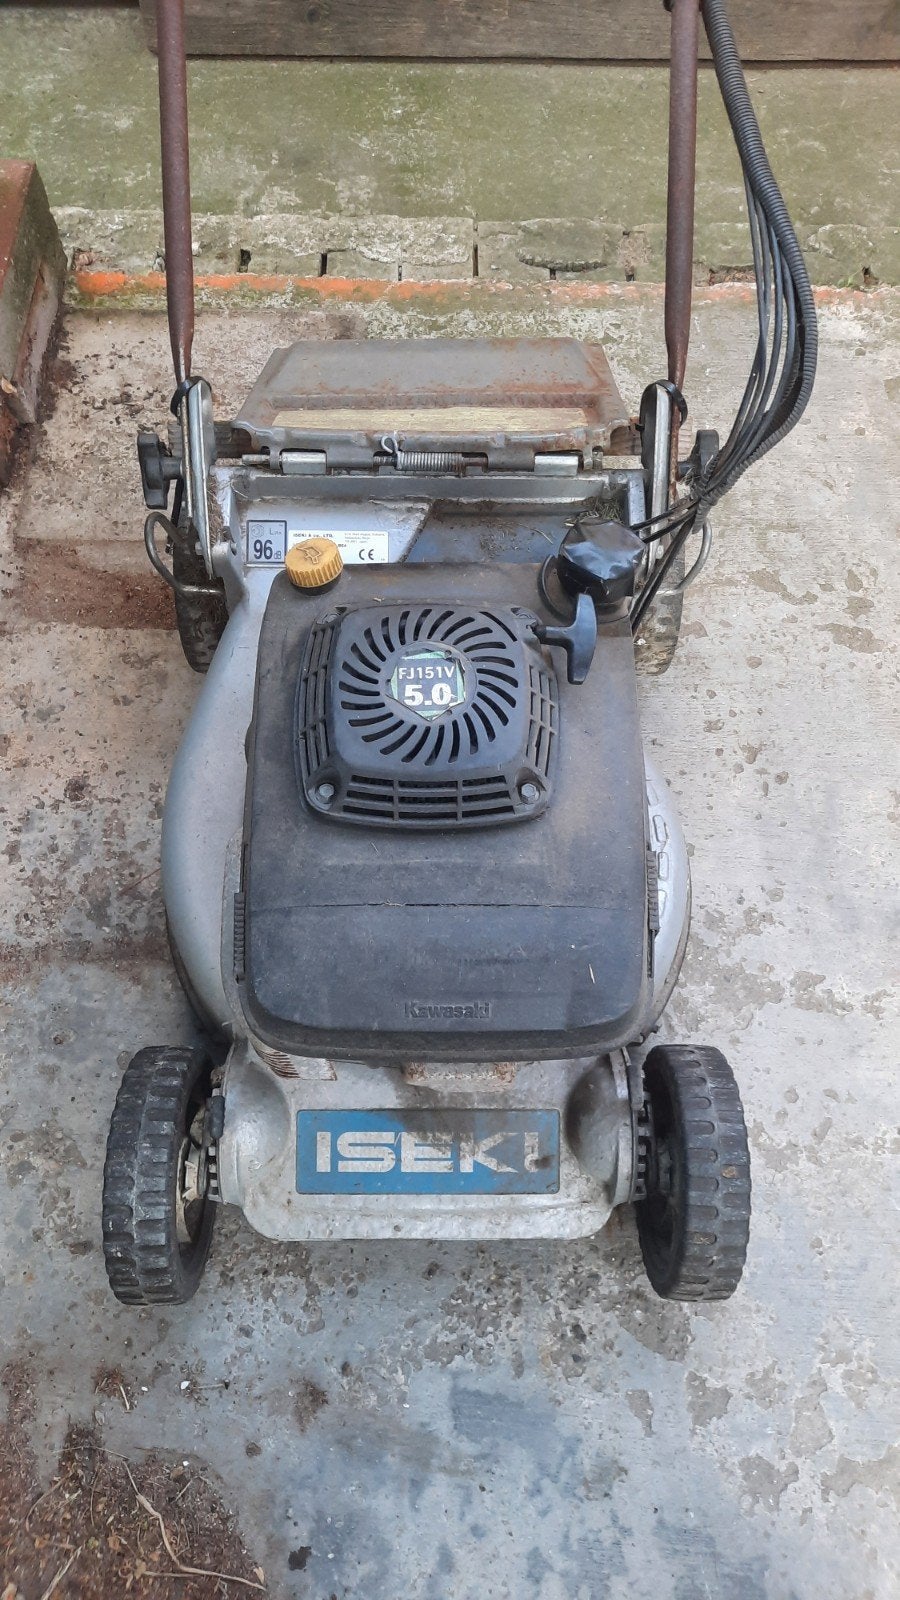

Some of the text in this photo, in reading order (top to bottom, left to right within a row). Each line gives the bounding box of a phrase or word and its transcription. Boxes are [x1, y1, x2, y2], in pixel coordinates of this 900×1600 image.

[254, 539, 273, 560] 96
[358, 548, 375, 561] CE
[398, 666, 454, 680] FJ151V
[403, 683, 452, 706] 5.0
[404, 1001, 490, 1018] Kawasaki
[317, 1131, 539, 1173] ISEKI
